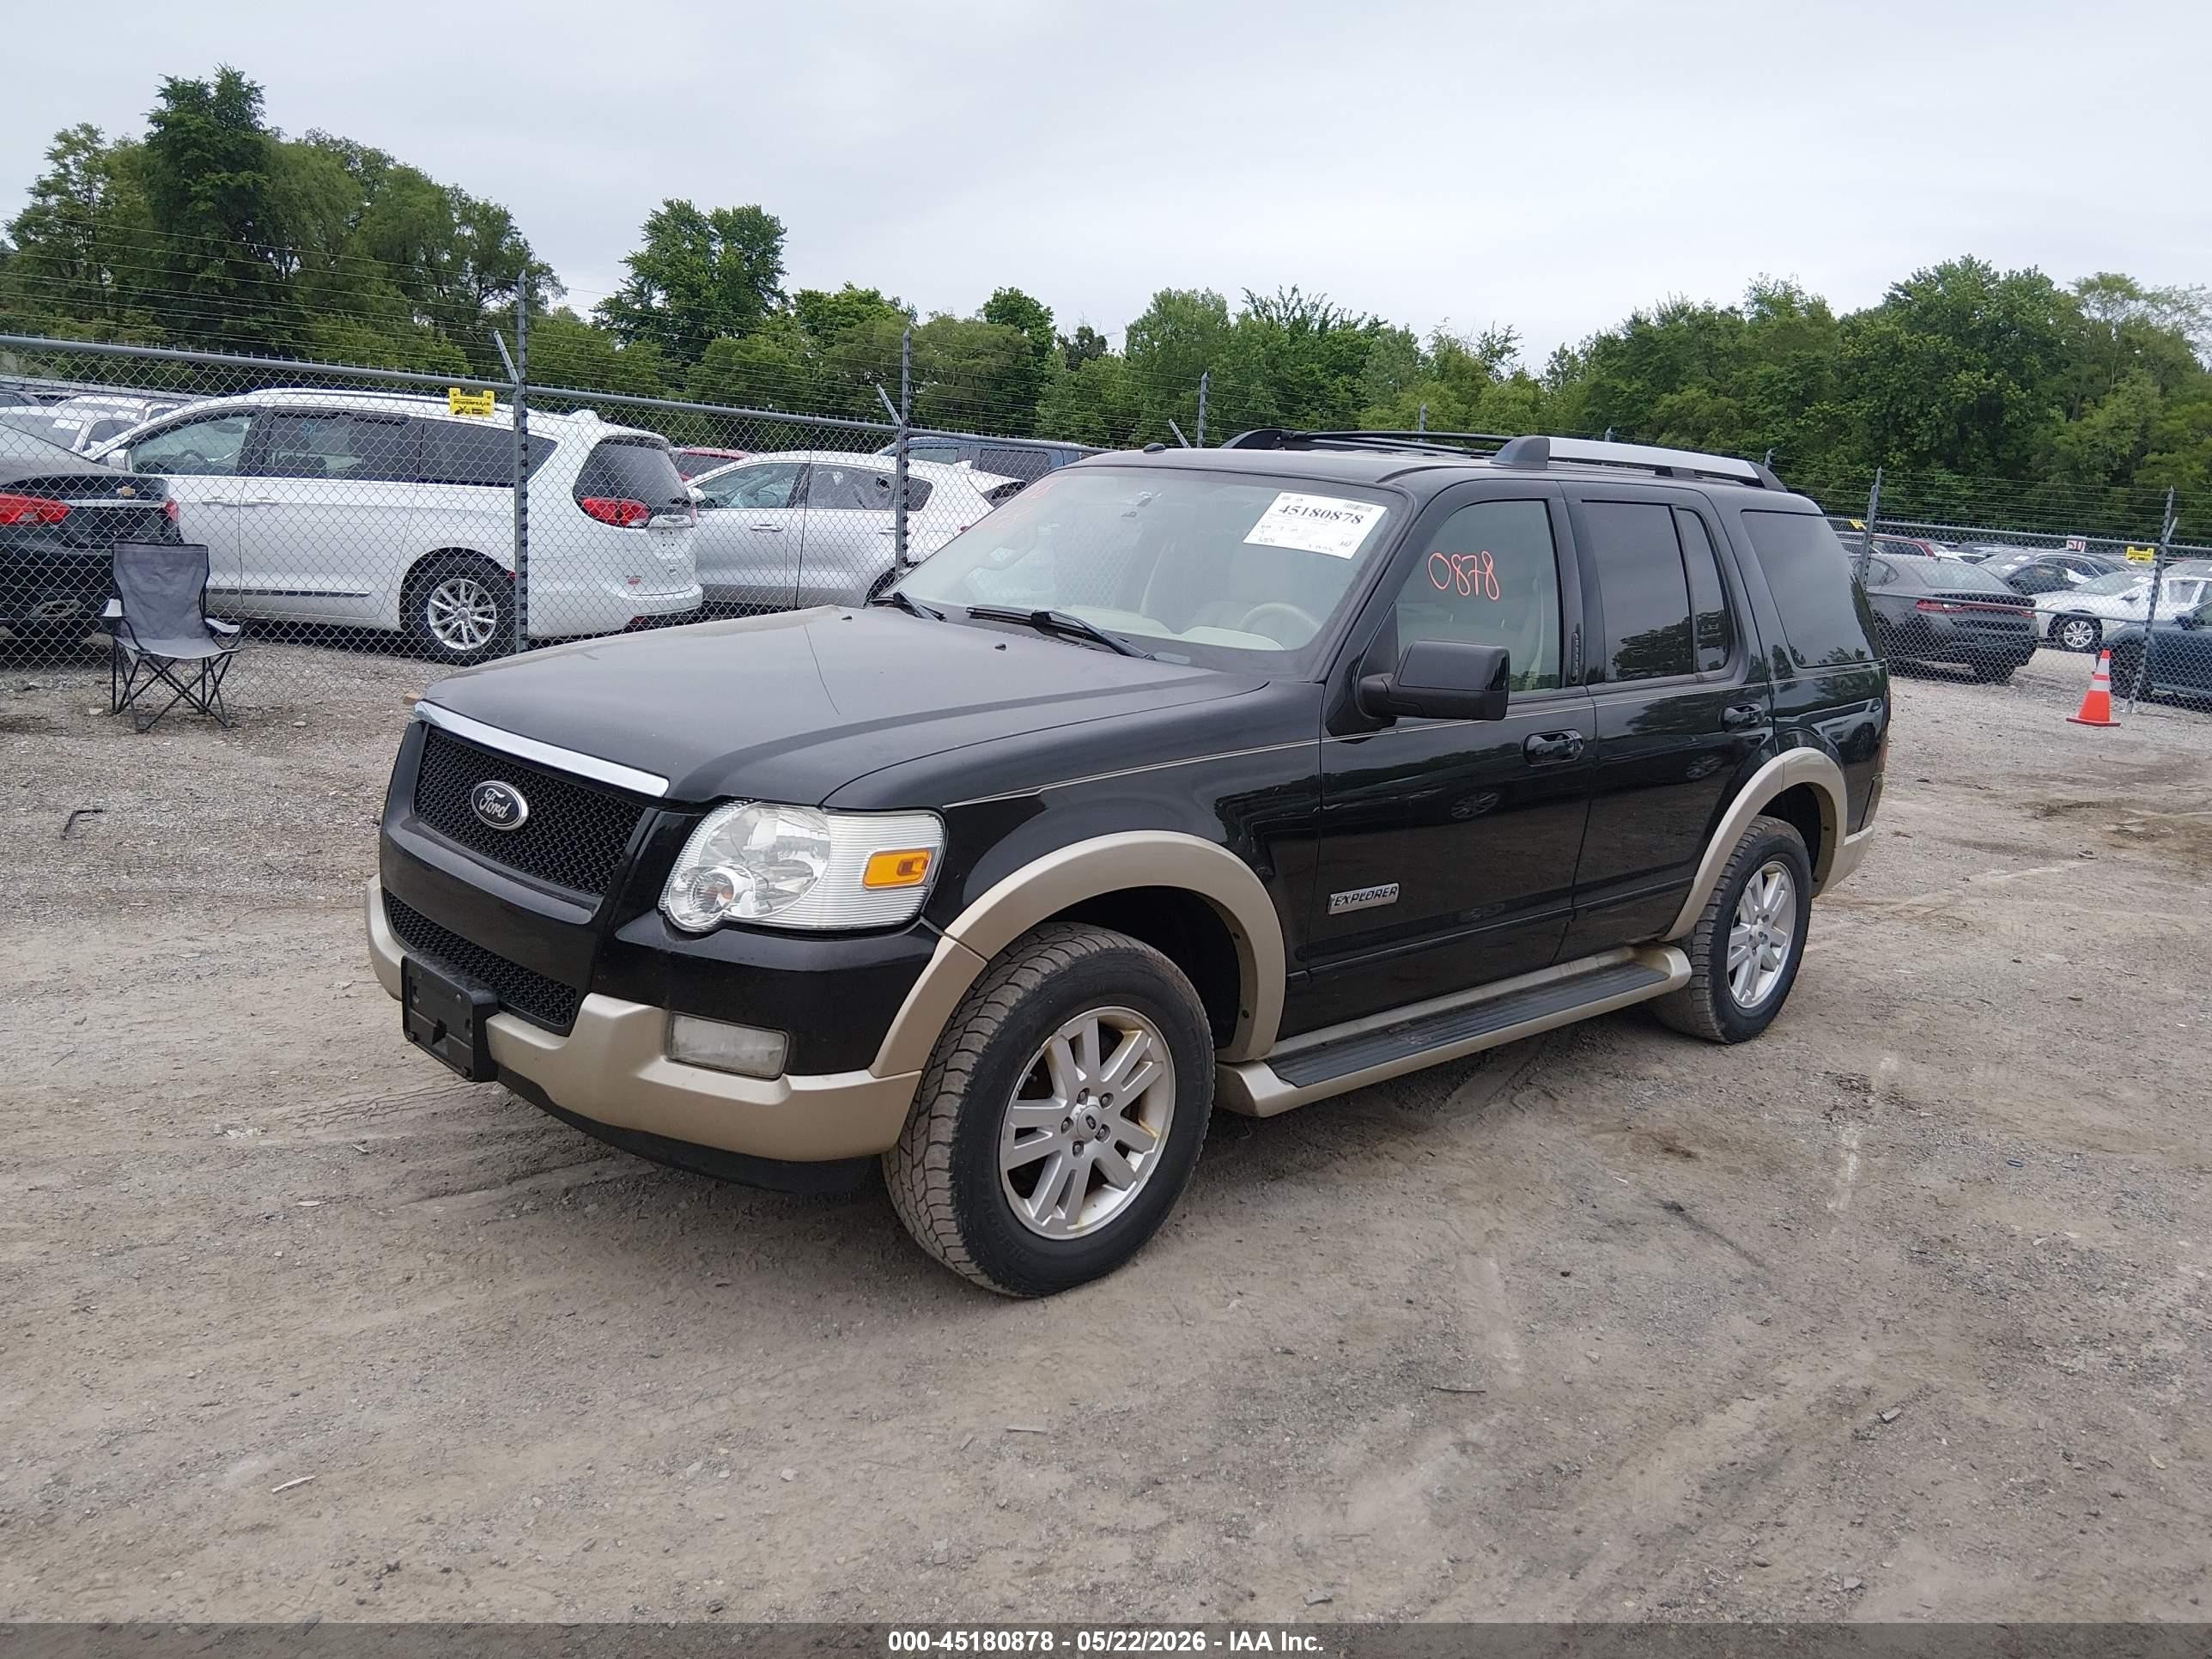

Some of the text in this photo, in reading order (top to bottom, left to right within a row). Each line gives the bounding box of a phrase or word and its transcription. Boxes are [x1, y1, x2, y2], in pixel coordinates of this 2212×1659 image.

[1278, 504, 1364, 525] 45180878
[1427, 550, 1500, 600] 0878
[479, 787, 512, 818] Ford
[1334, 886, 1398, 907] EXPLORER
